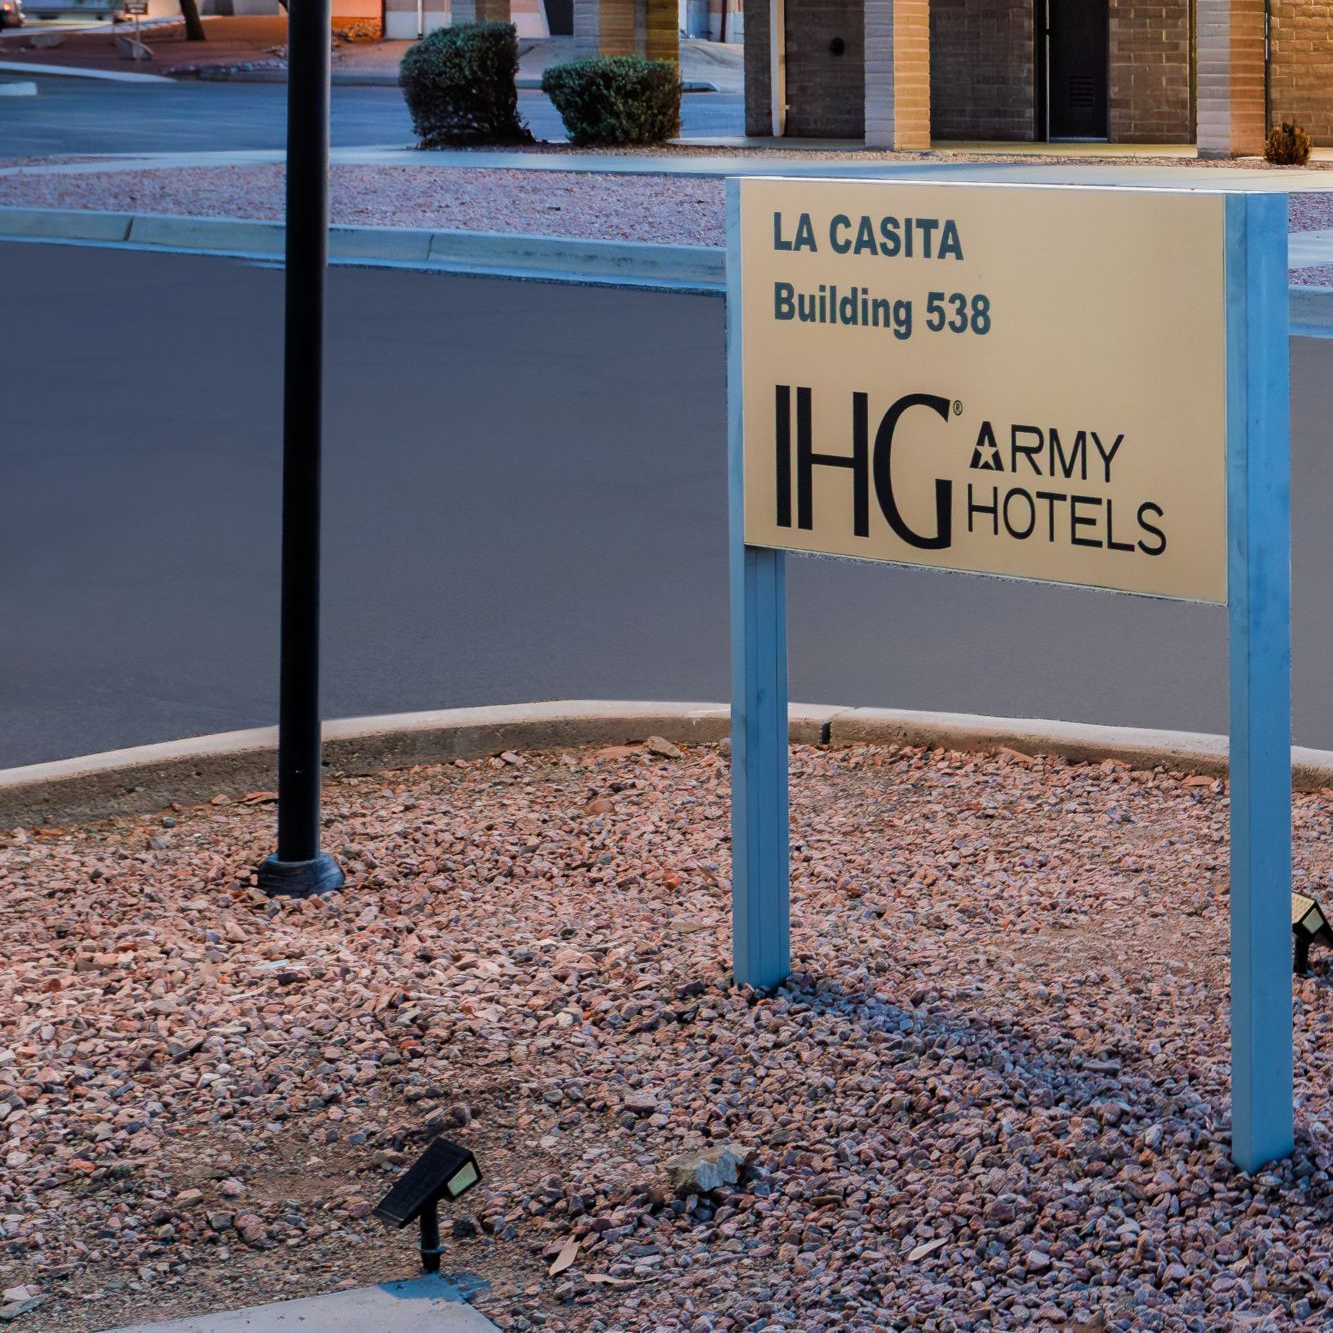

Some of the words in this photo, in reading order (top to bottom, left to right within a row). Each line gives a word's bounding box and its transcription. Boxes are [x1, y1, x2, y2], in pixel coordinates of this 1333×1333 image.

[773, 211, 818, 253] LA
[829, 214, 965, 261] CASITA
[774, 281, 913, 341] Building
[926, 291, 992, 336] 538
[774, 384, 952, 550] IHG
[968, 420, 1125, 483] ARMY
[967, 483, 1168, 557] HOTELS
